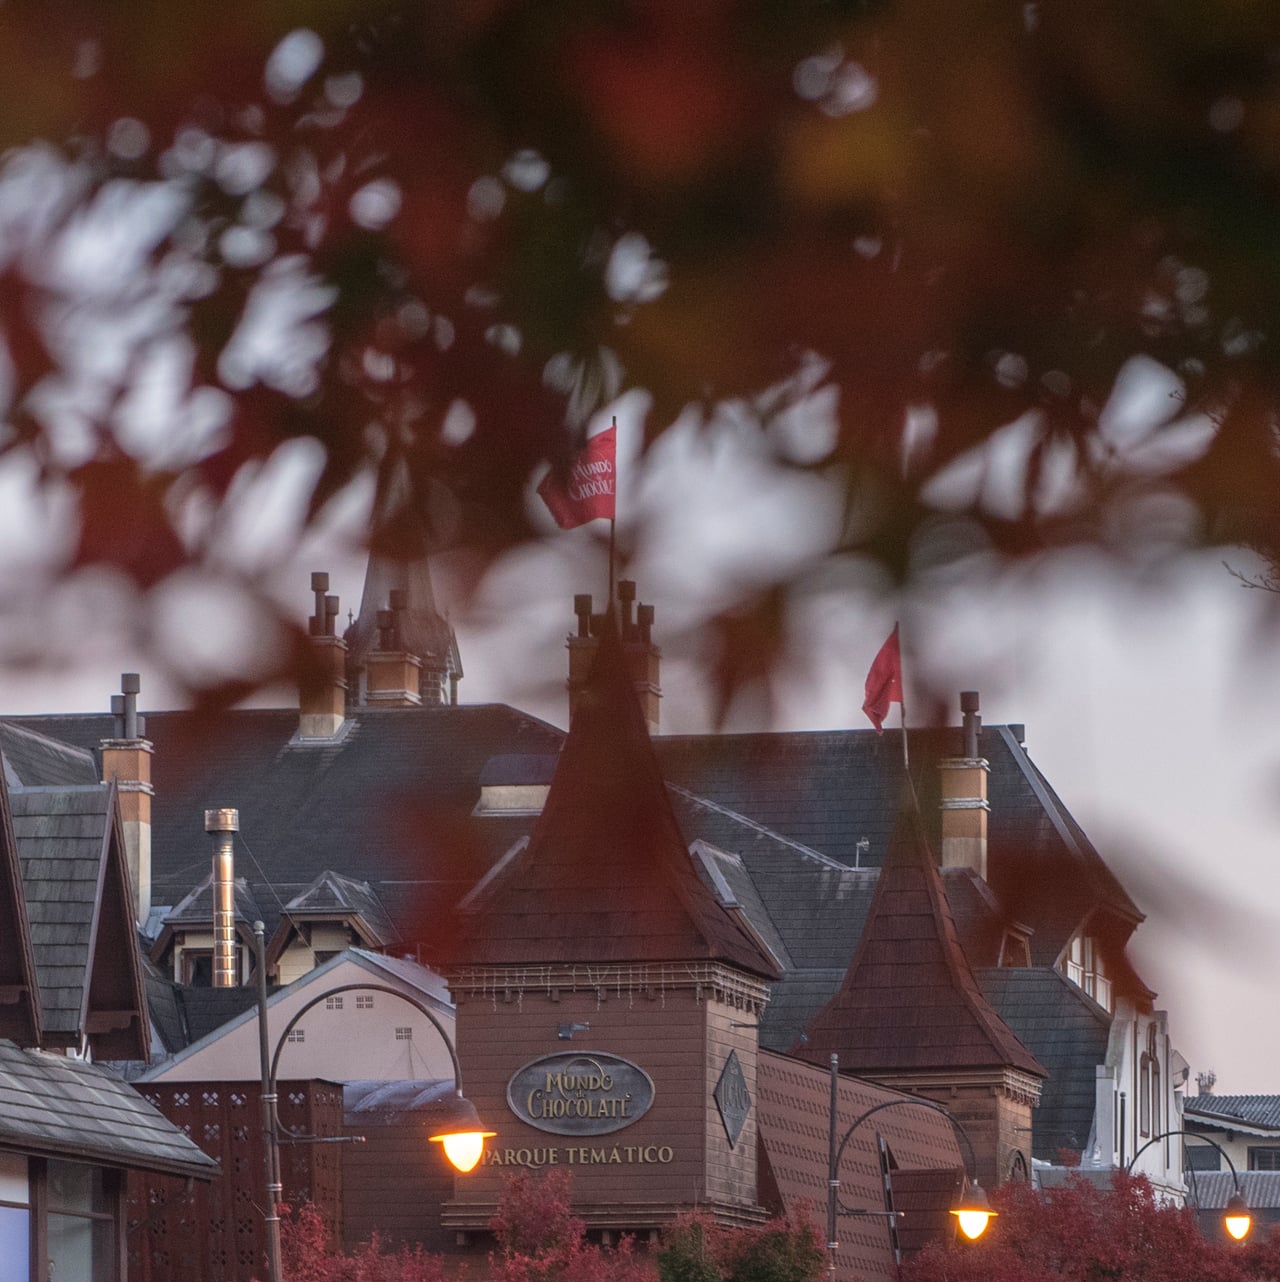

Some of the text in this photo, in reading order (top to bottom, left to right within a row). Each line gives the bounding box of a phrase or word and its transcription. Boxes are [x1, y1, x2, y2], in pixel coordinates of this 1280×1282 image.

[545, 1072, 613, 1097] MUNDO
[527, 1088, 632, 1119] CHOCOLATE
[482, 1143, 674, 1169] PARQUE TEMÁTICO
